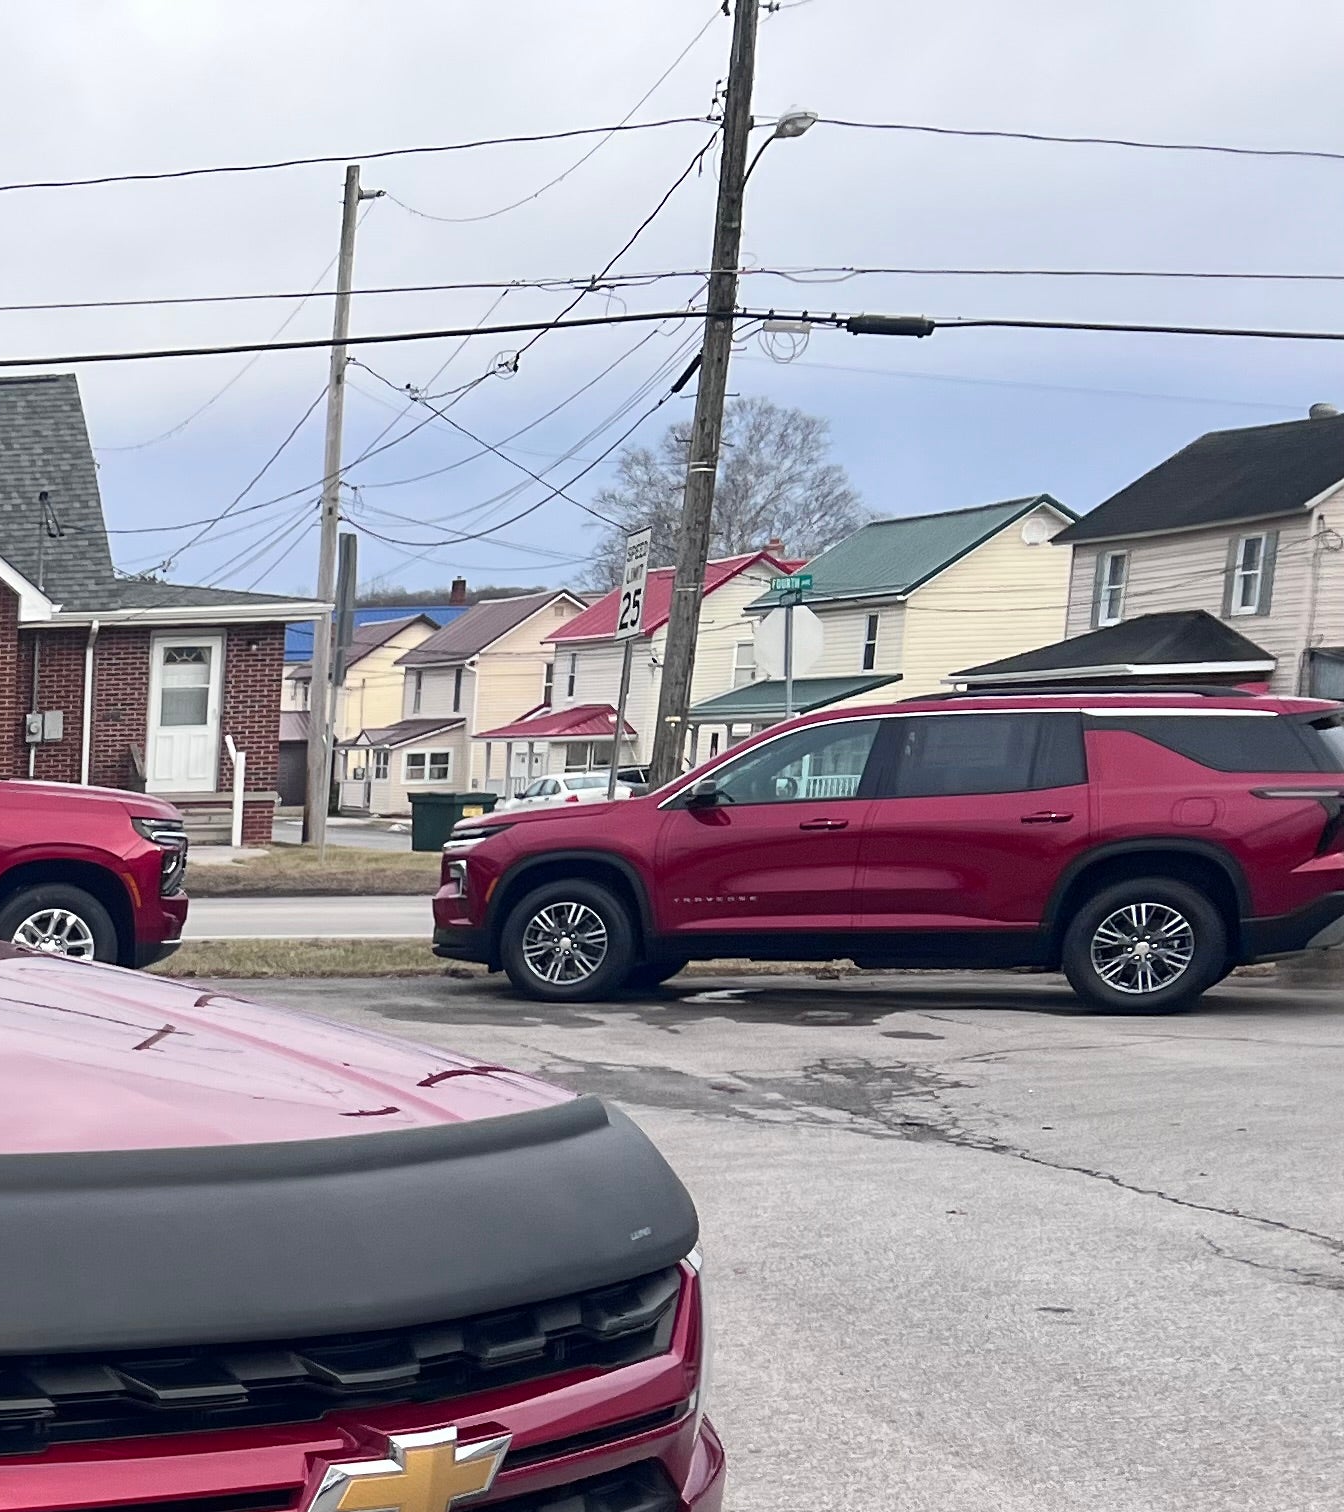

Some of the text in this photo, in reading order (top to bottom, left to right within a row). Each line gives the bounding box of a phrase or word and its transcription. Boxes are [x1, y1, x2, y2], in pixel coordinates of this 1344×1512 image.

[628, 541, 648, 562] SPEED
[626, 564, 644, 584] LIMIT
[772, 577, 800, 590] FOURTH
[618, 588, 642, 630] 25
